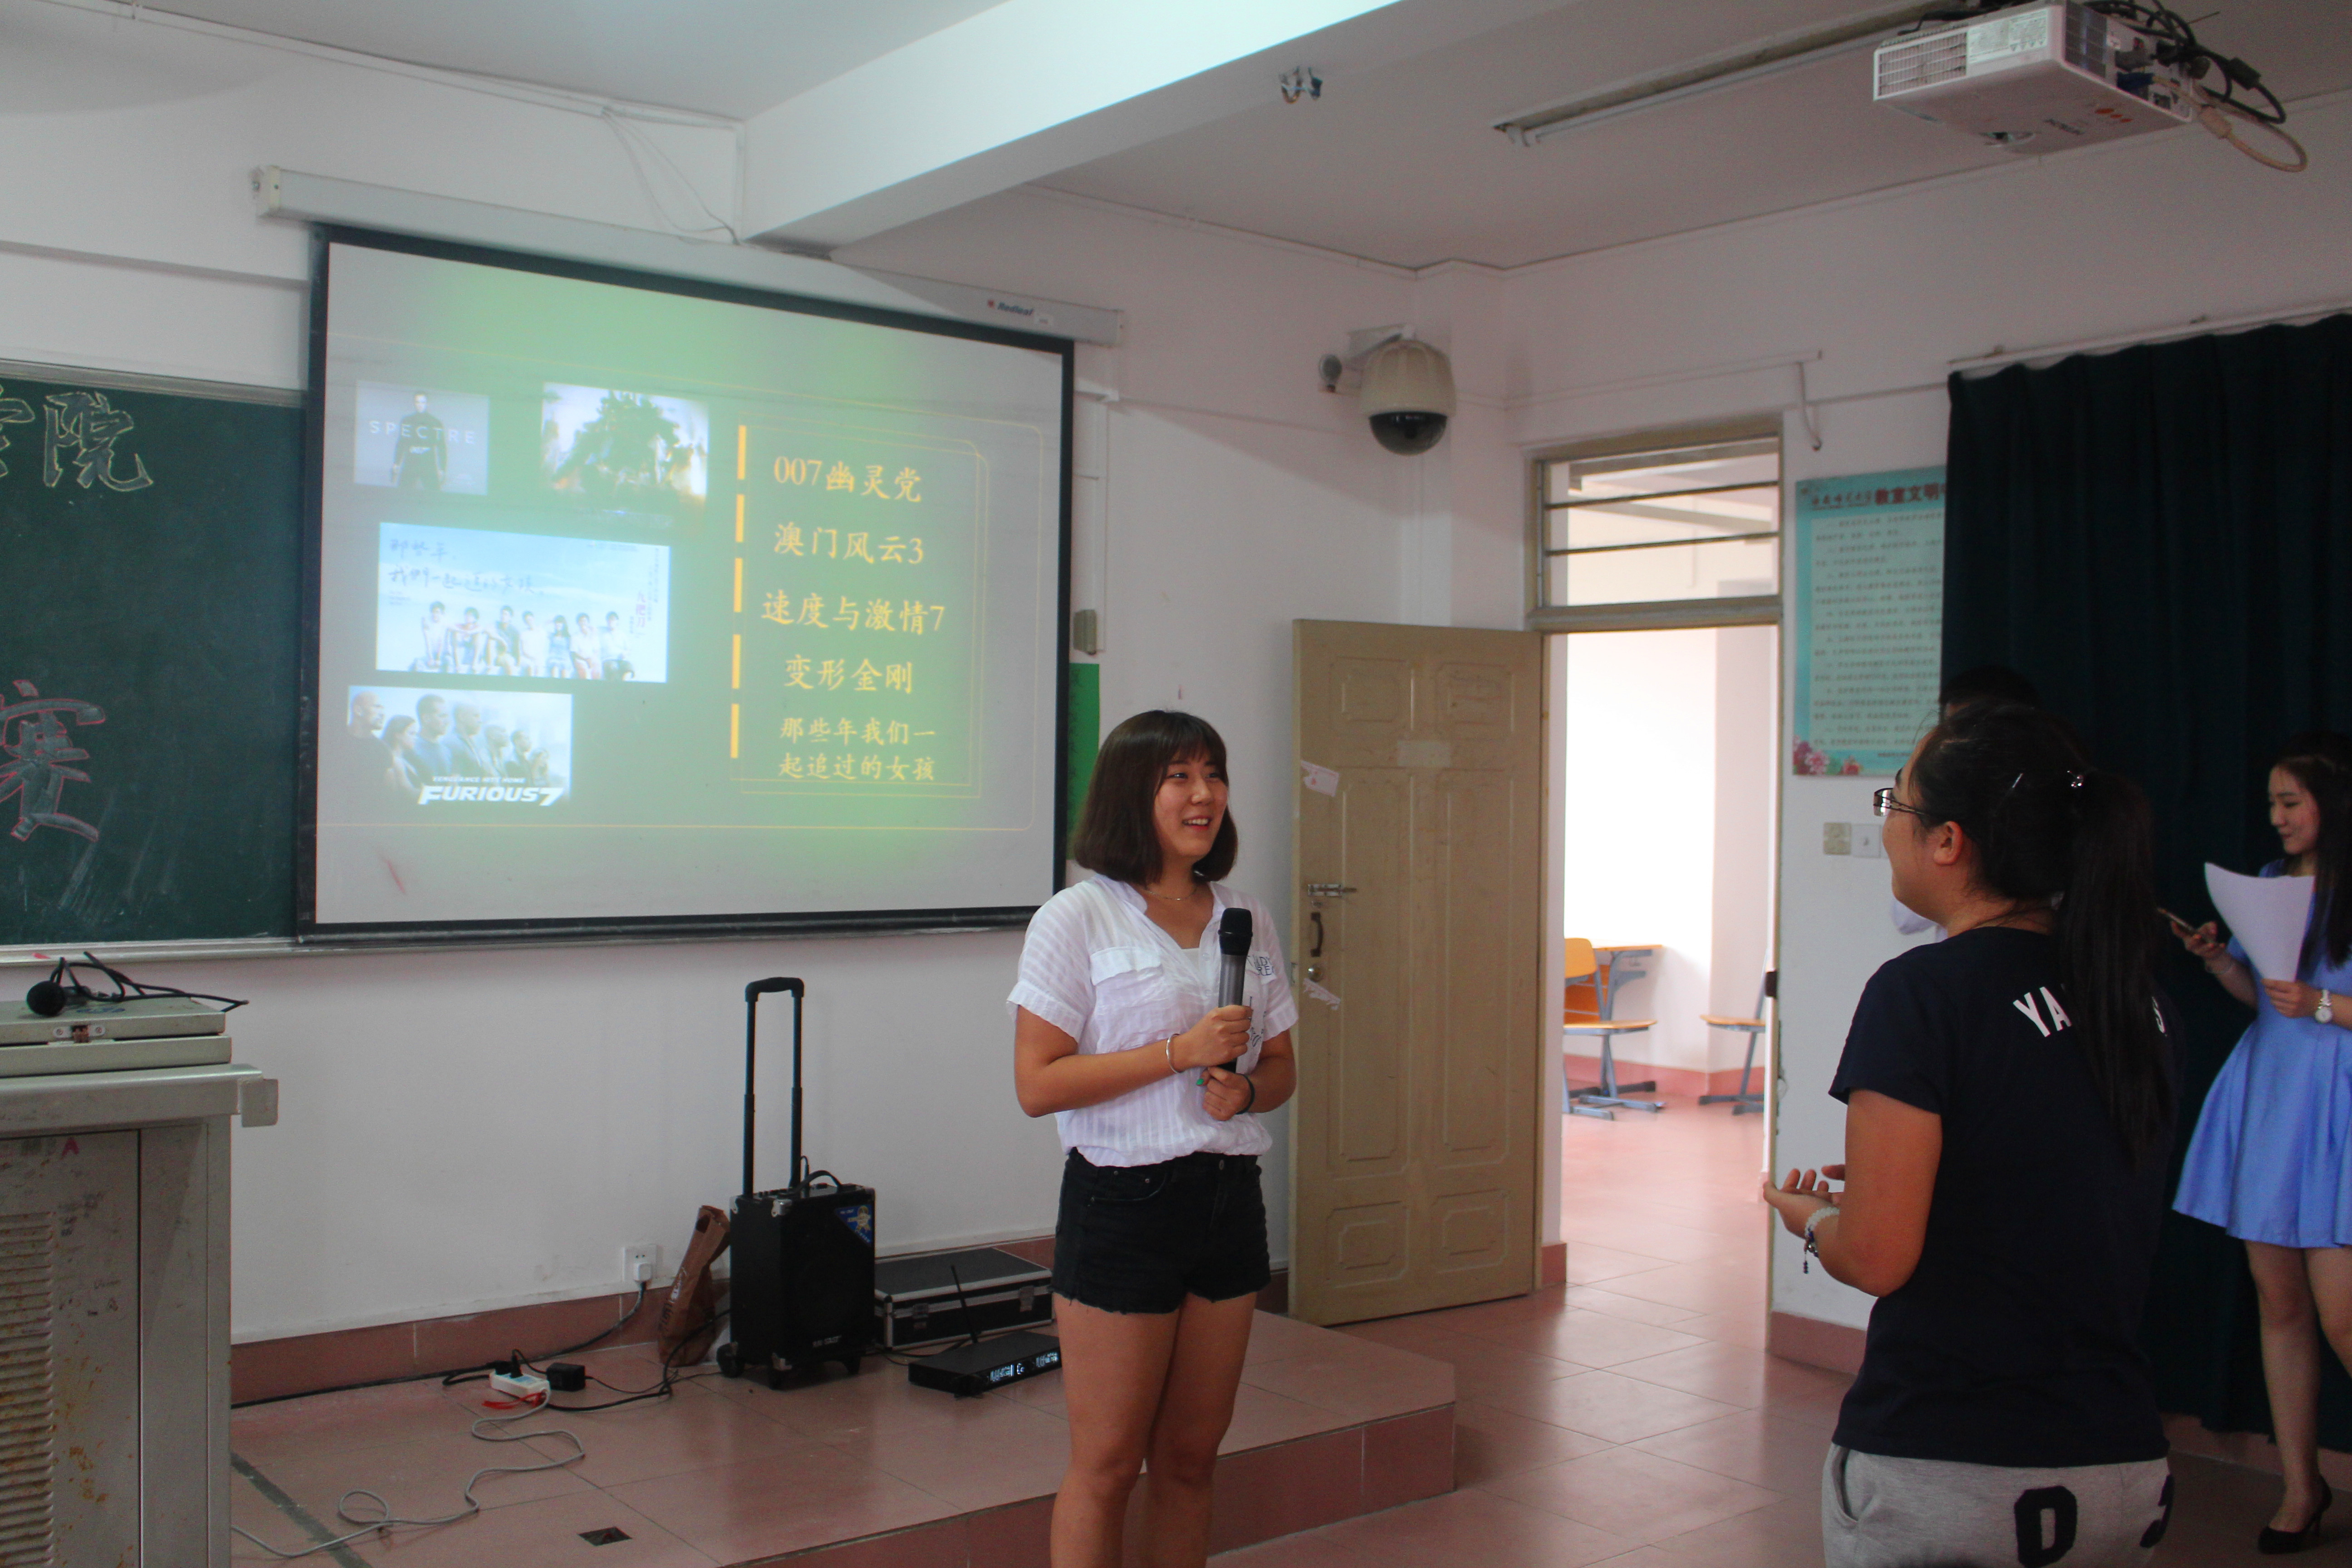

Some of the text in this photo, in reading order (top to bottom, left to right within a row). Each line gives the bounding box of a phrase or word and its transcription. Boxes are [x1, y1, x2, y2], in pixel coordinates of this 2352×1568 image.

[369, 420, 476, 445] SPECTRE
[773, 456, 921, 503] 007幽灵党
[773, 521, 924, 564] 澳门风云3
[761, 589, 945, 635] 速度与激情7
[784, 654, 913, 694] 变形金刚
[779, 717, 936, 746] 那些年我们一
[778, 752, 936, 781] 起追过的女孩
